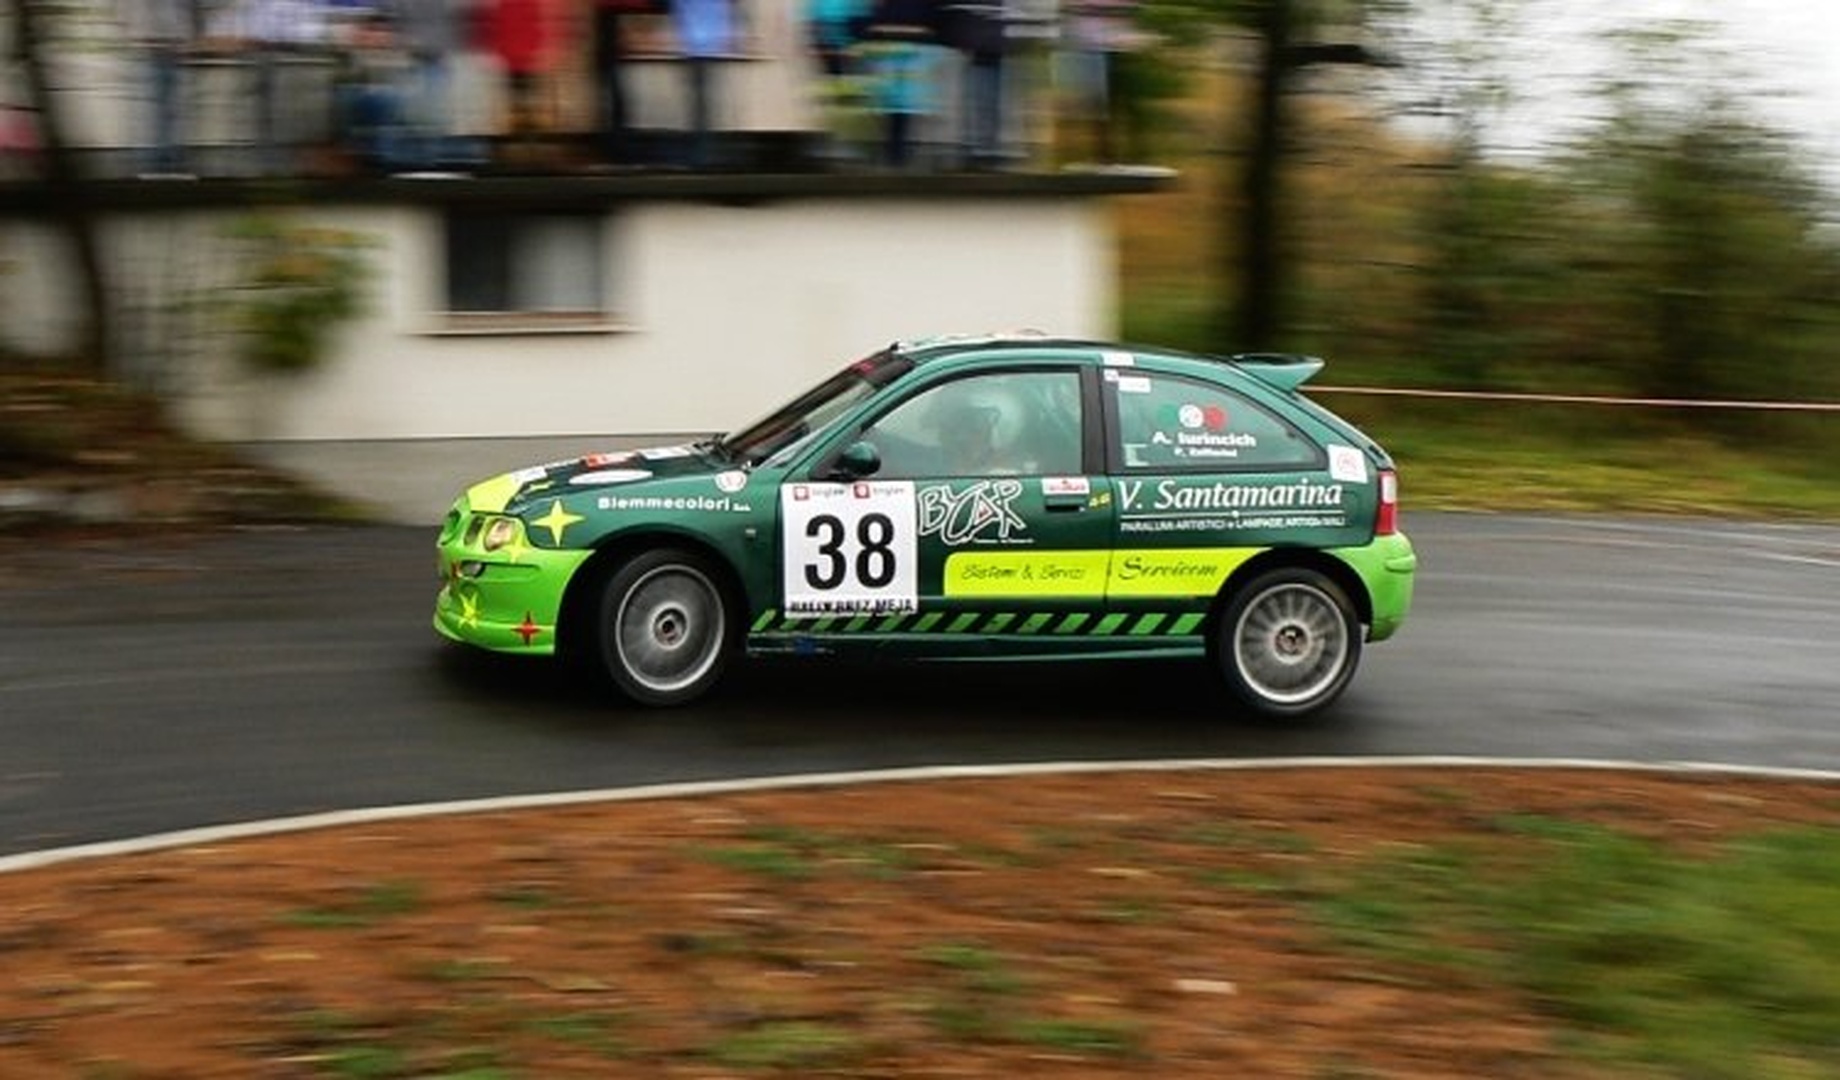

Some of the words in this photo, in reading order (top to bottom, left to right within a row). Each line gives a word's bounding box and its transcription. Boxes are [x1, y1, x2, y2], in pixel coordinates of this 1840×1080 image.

[1118, 480, 1143, 510] V.
[1153, 477, 1343, 510] Santamarina
[804, 512, 896, 590] 38
